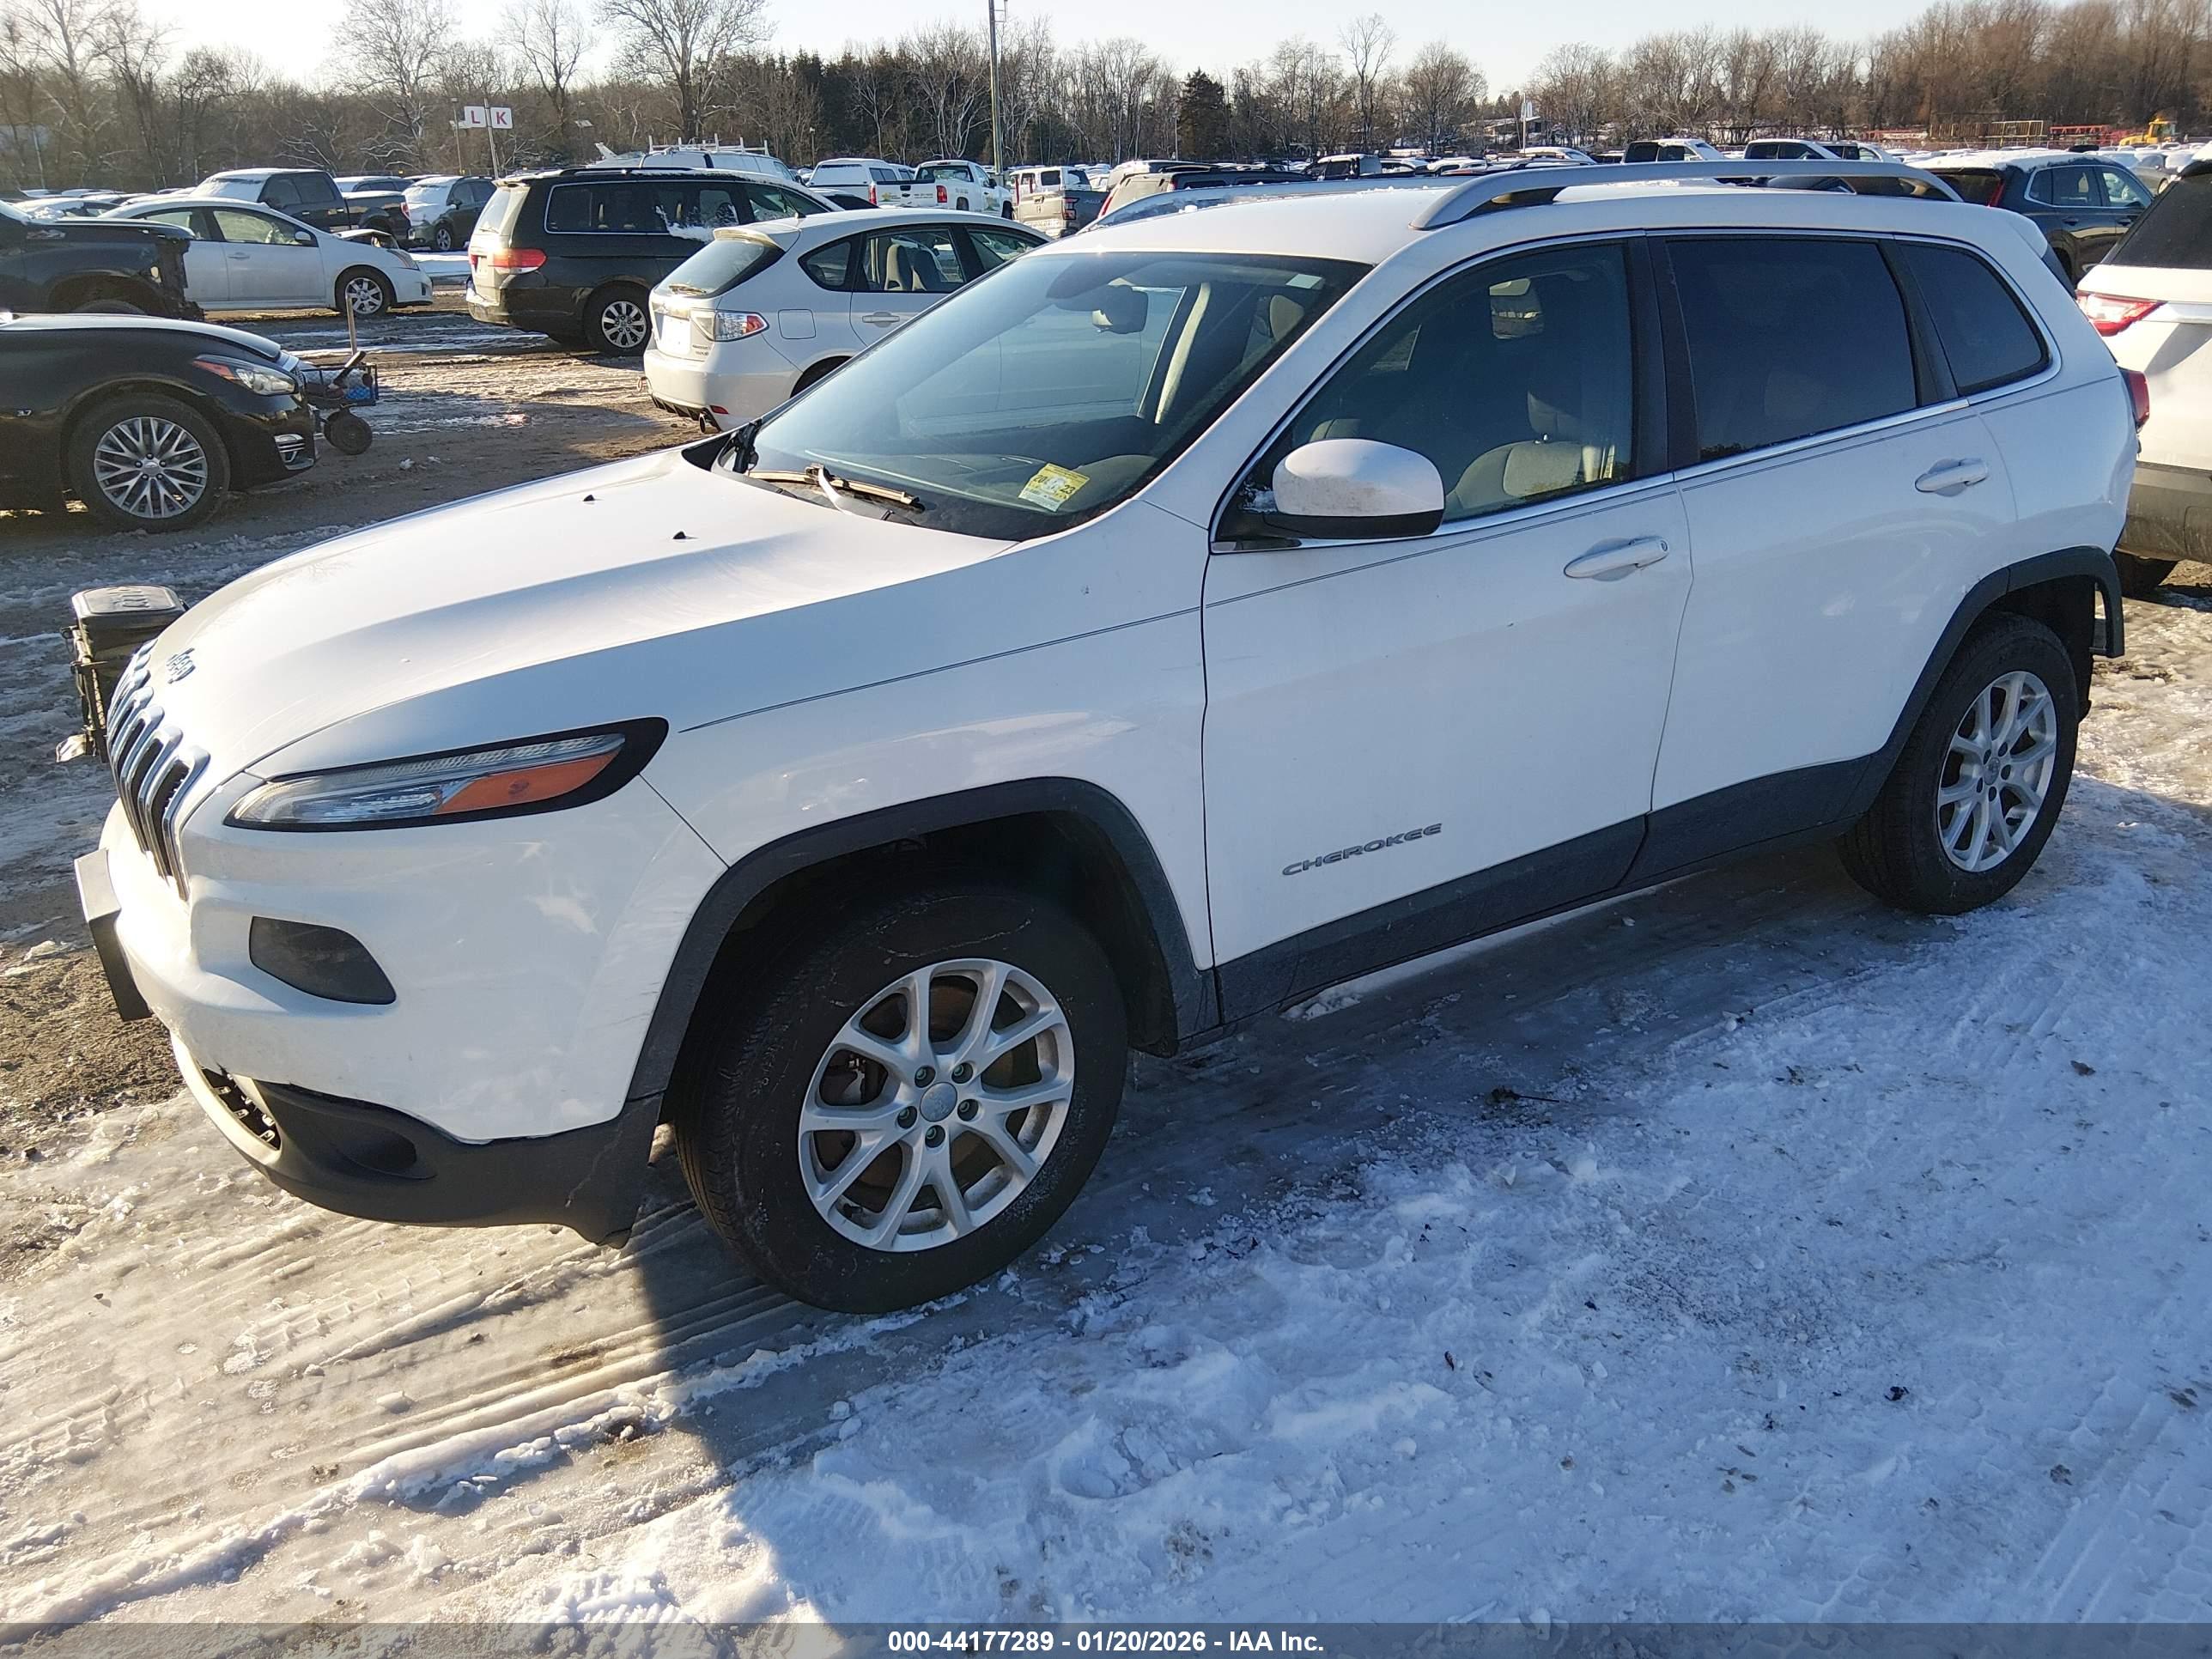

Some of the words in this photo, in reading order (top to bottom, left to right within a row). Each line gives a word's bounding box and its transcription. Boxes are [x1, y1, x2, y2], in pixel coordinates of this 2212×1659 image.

[471, 110, 481, 125] L
[495, 111, 507, 125] K
[1060, 484, 1076, 495] 23
[1282, 823, 1443, 876] CHEROKEE
